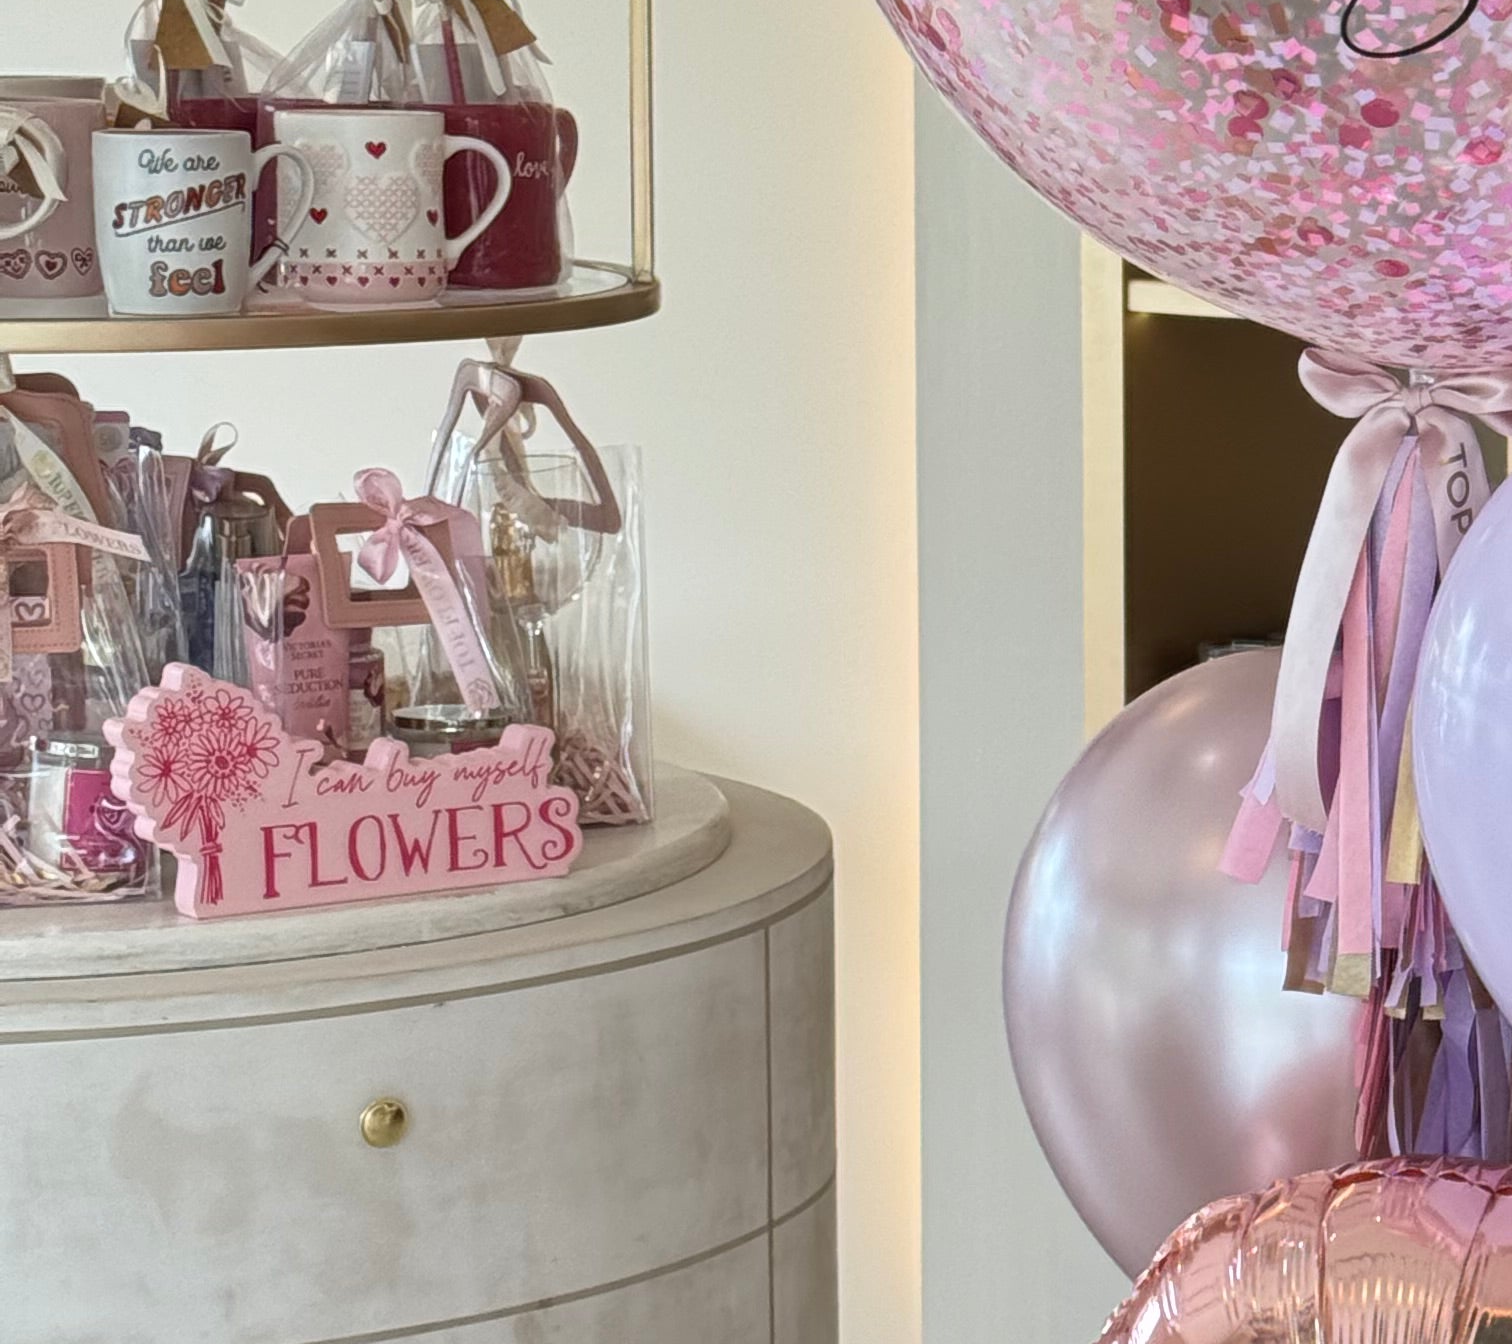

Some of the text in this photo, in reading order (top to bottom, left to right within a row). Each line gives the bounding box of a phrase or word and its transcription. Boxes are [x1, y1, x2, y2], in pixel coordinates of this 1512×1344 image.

[138, 148, 220, 174] We are
[112, 172, 247, 230] STRONGER
[147, 234, 227, 253] than we
[149, 259, 226, 298] feel
[1440, 442, 1474, 535] TOP
[294, 667, 325, 680] PURE
[282, 736, 549, 809] I can buy myself
[259, 796, 575, 901] FLOWERS
